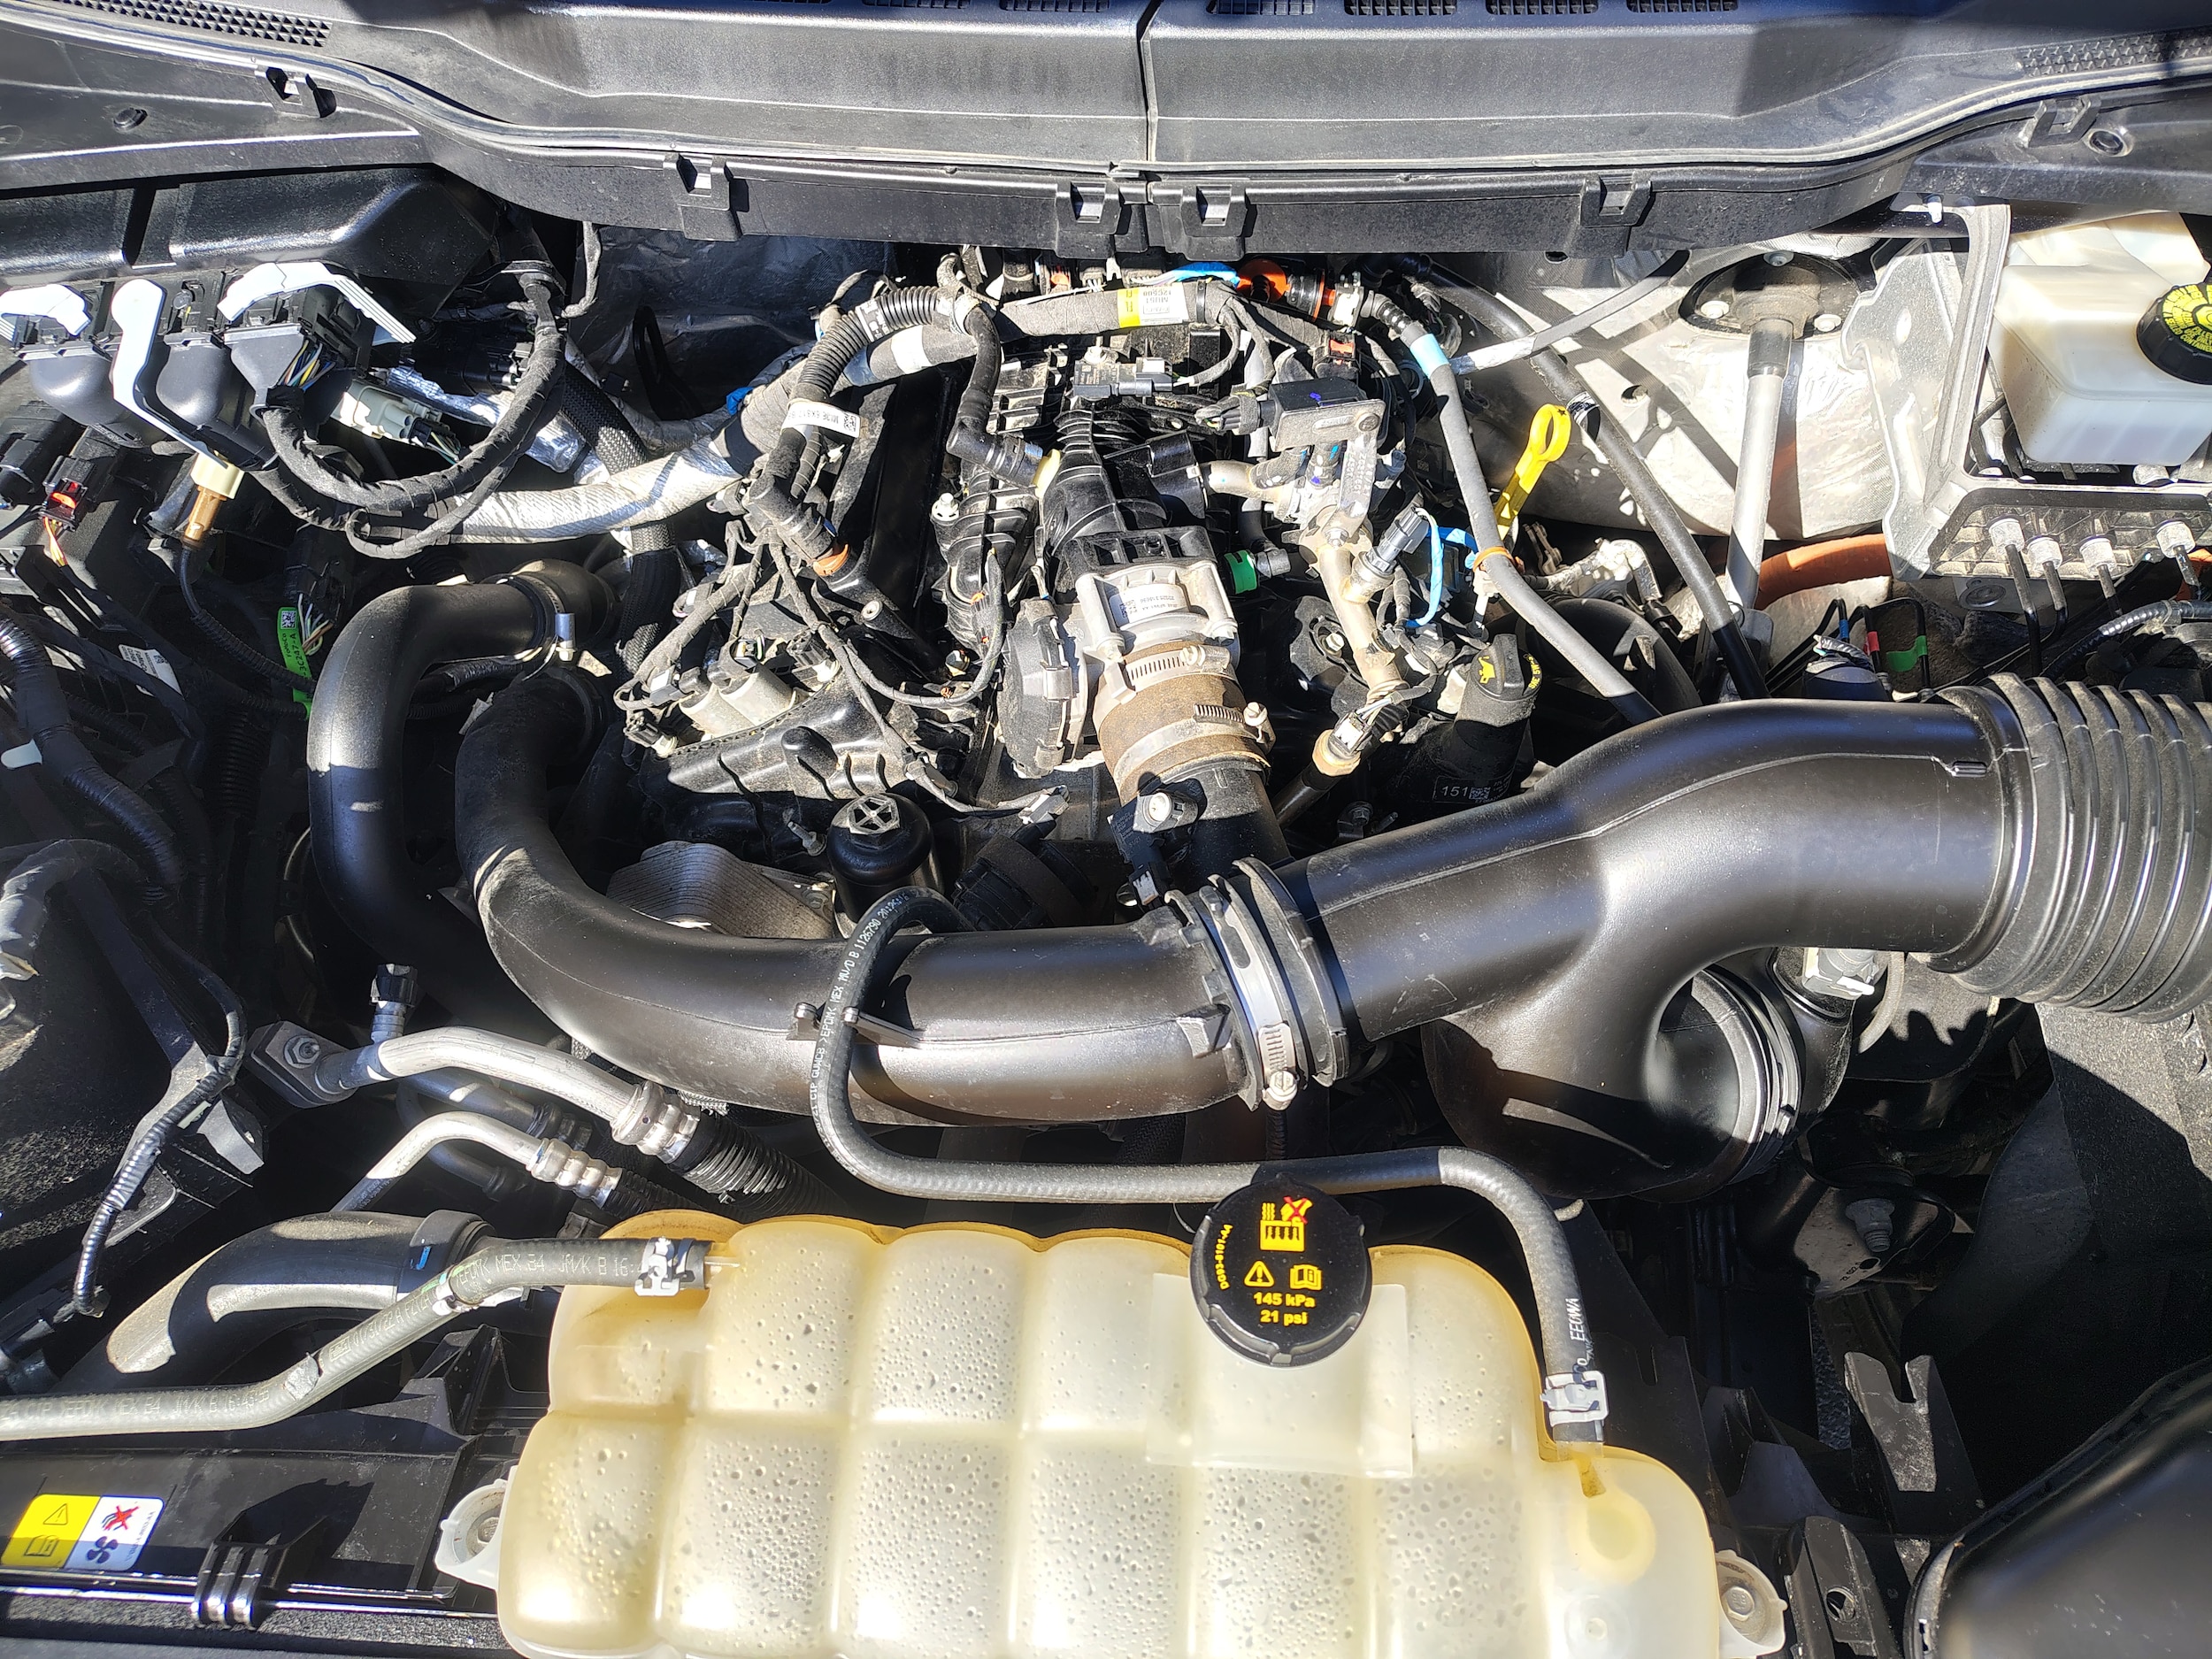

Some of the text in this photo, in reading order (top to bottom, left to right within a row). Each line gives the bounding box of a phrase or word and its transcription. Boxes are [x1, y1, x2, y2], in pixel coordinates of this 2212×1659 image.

[1528, 676, 1540, 689] SAE
[1441, 785, 1469, 797] 151
[810, 1081, 818, 1101] CIP
[818, 1006, 837, 1044] >EPDM<
[829, 985, 844, 1003] MEX
[495, 1253, 522, 1272] MEX
[1253, 1291, 1317, 1308] 145 kPa
[1260, 1309, 1309, 1326] 21 psi
